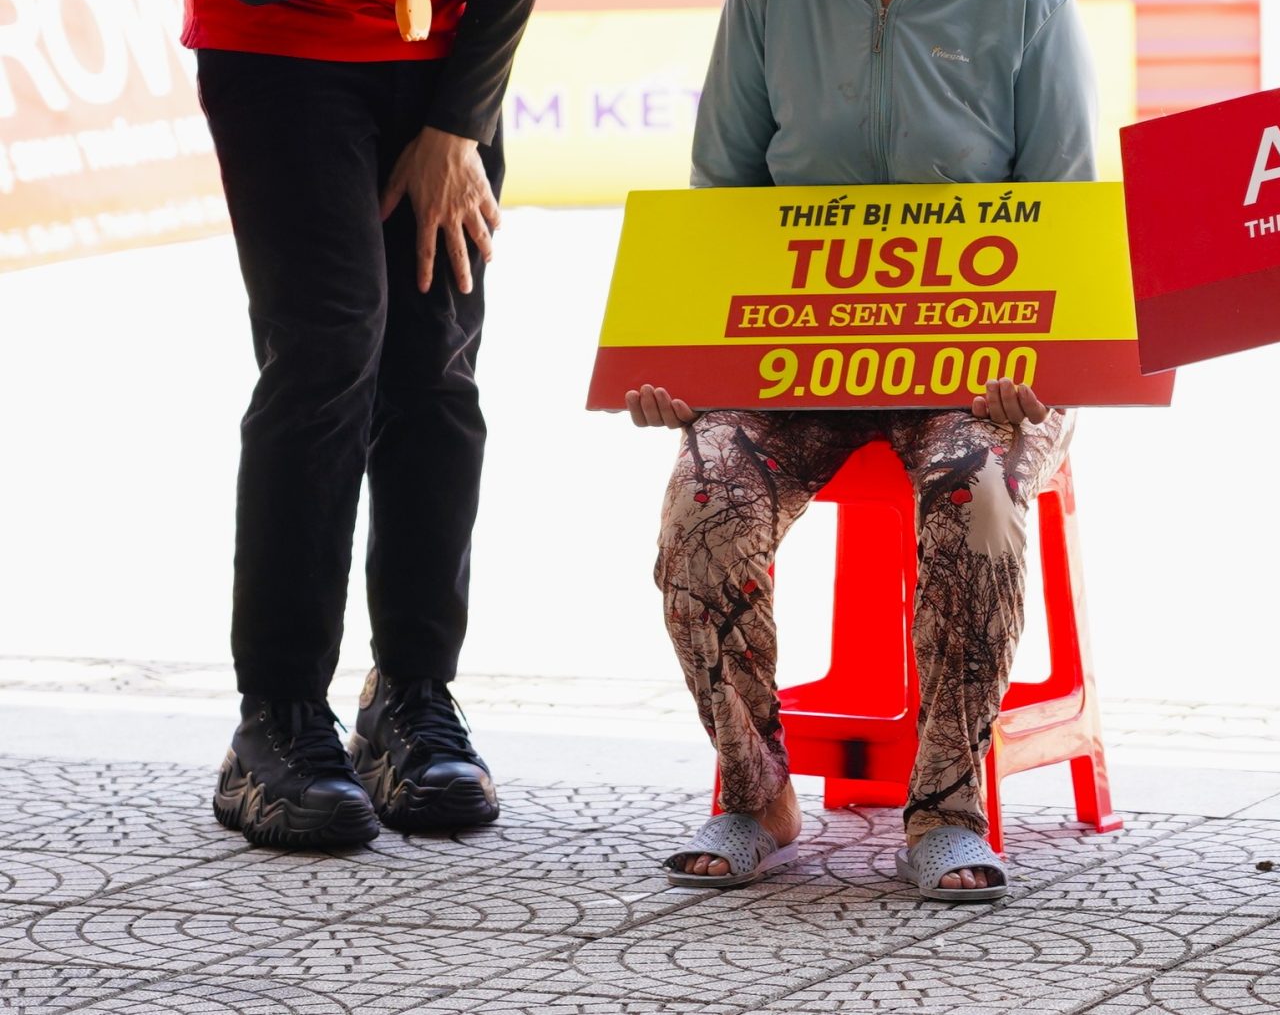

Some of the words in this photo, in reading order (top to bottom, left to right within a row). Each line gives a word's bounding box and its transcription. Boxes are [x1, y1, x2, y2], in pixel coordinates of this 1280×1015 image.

[779, 194, 855, 227] THIẾT
[863, 204, 891, 232] BỊ
[900, 194, 966, 225] NHÀ
[978, 189, 1041, 224] TẮM
[787, 235, 1019, 289] TUSLO
[738, 304, 818, 329] HOA
[829, 302, 908, 327] SEN
[759, 346, 1038, 400] 9.000.000
